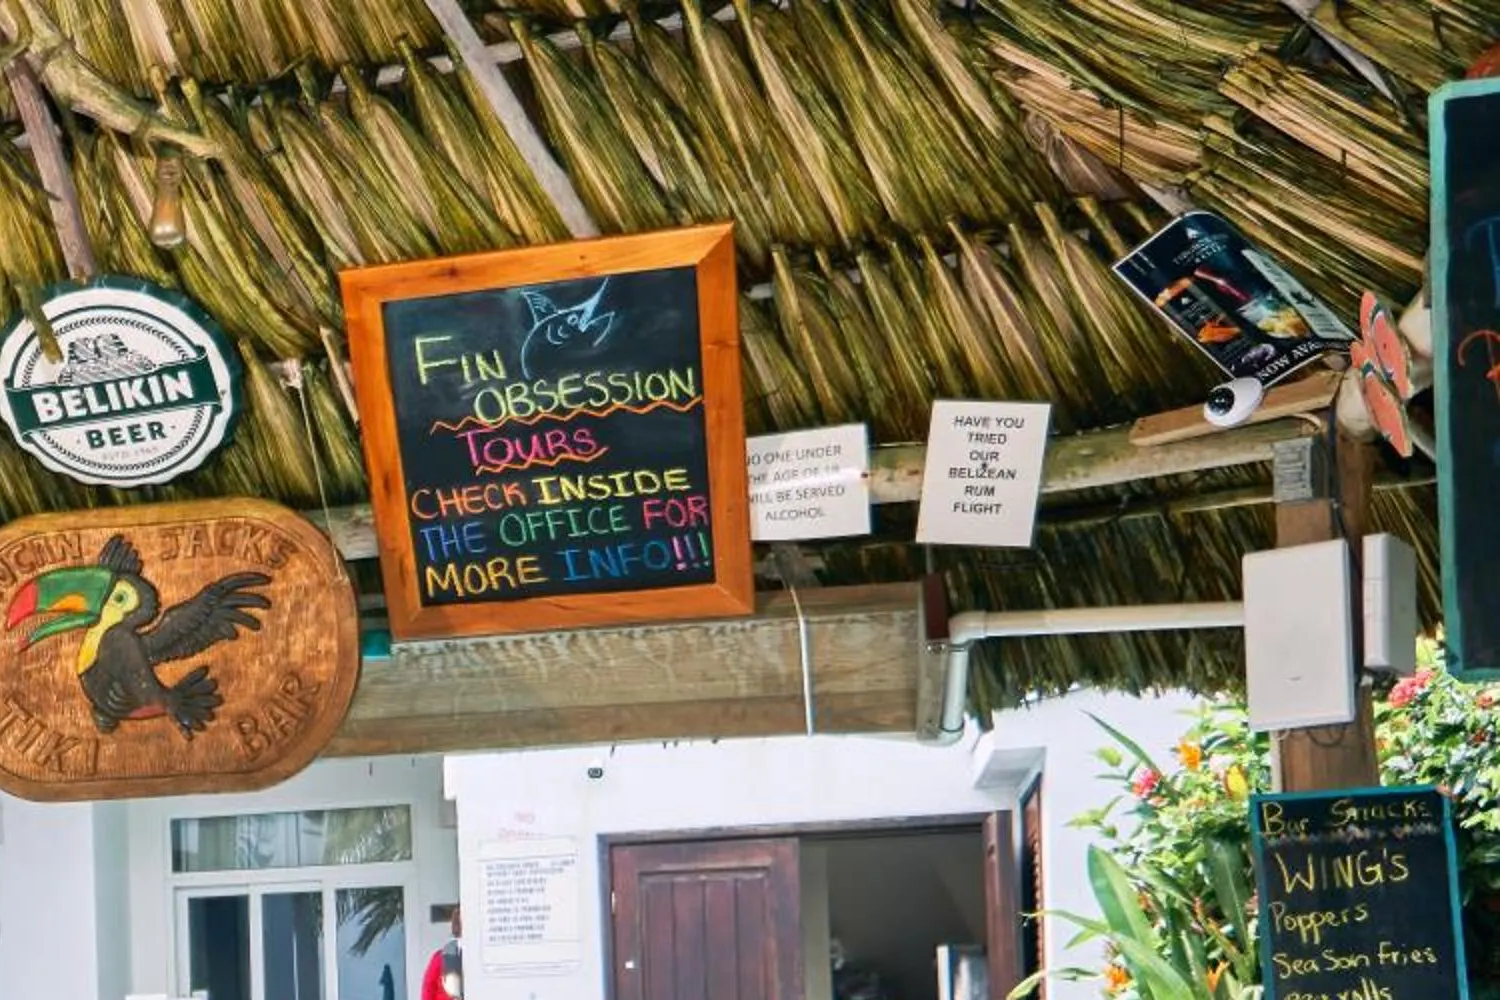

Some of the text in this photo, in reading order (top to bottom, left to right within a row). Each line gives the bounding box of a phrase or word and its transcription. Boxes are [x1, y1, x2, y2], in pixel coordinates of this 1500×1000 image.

[415, 336, 507, 389] FIN
[1257, 356, 1290, 381] NOW
[31, 370, 194, 423] BELIKIN
[474, 367, 696, 423] OBSESSION
[85, 420, 168, 450] BEER
[954, 416, 1025, 429] HAVE YOU
[456, 428, 598, 467] TOURS
[968, 432, 1007, 445] TRIED
[764, 450, 791, 464] ONE
[796, 445, 842, 460] UNDER
[969, 450, 1000, 461] OUR
[774, 469, 798, 481] AGE
[803, 467, 820, 478] OF
[948, 467, 1017, 480] BELIZEAN
[411, 469, 692, 520] CHECK INSIDE
[776, 489, 792, 502] BE
[795, 486, 845, 501] SERVED
[964, 485, 995, 497] RUM
[765, 507, 826, 521] ALCOHOL
[953, 502, 1002, 515] FLIGHT
[420, 496, 709, 561] THE OFFICE FOR
[160, 527, 299, 567] JACKS
[425, 532, 710, 598] MORE INFO!!!
[234, 672, 321, 763] BAR
[1262, 801, 1309, 834] Bar
[1269, 901, 1368, 945] Poppers
[1377, 941, 1438, 967] Fries
